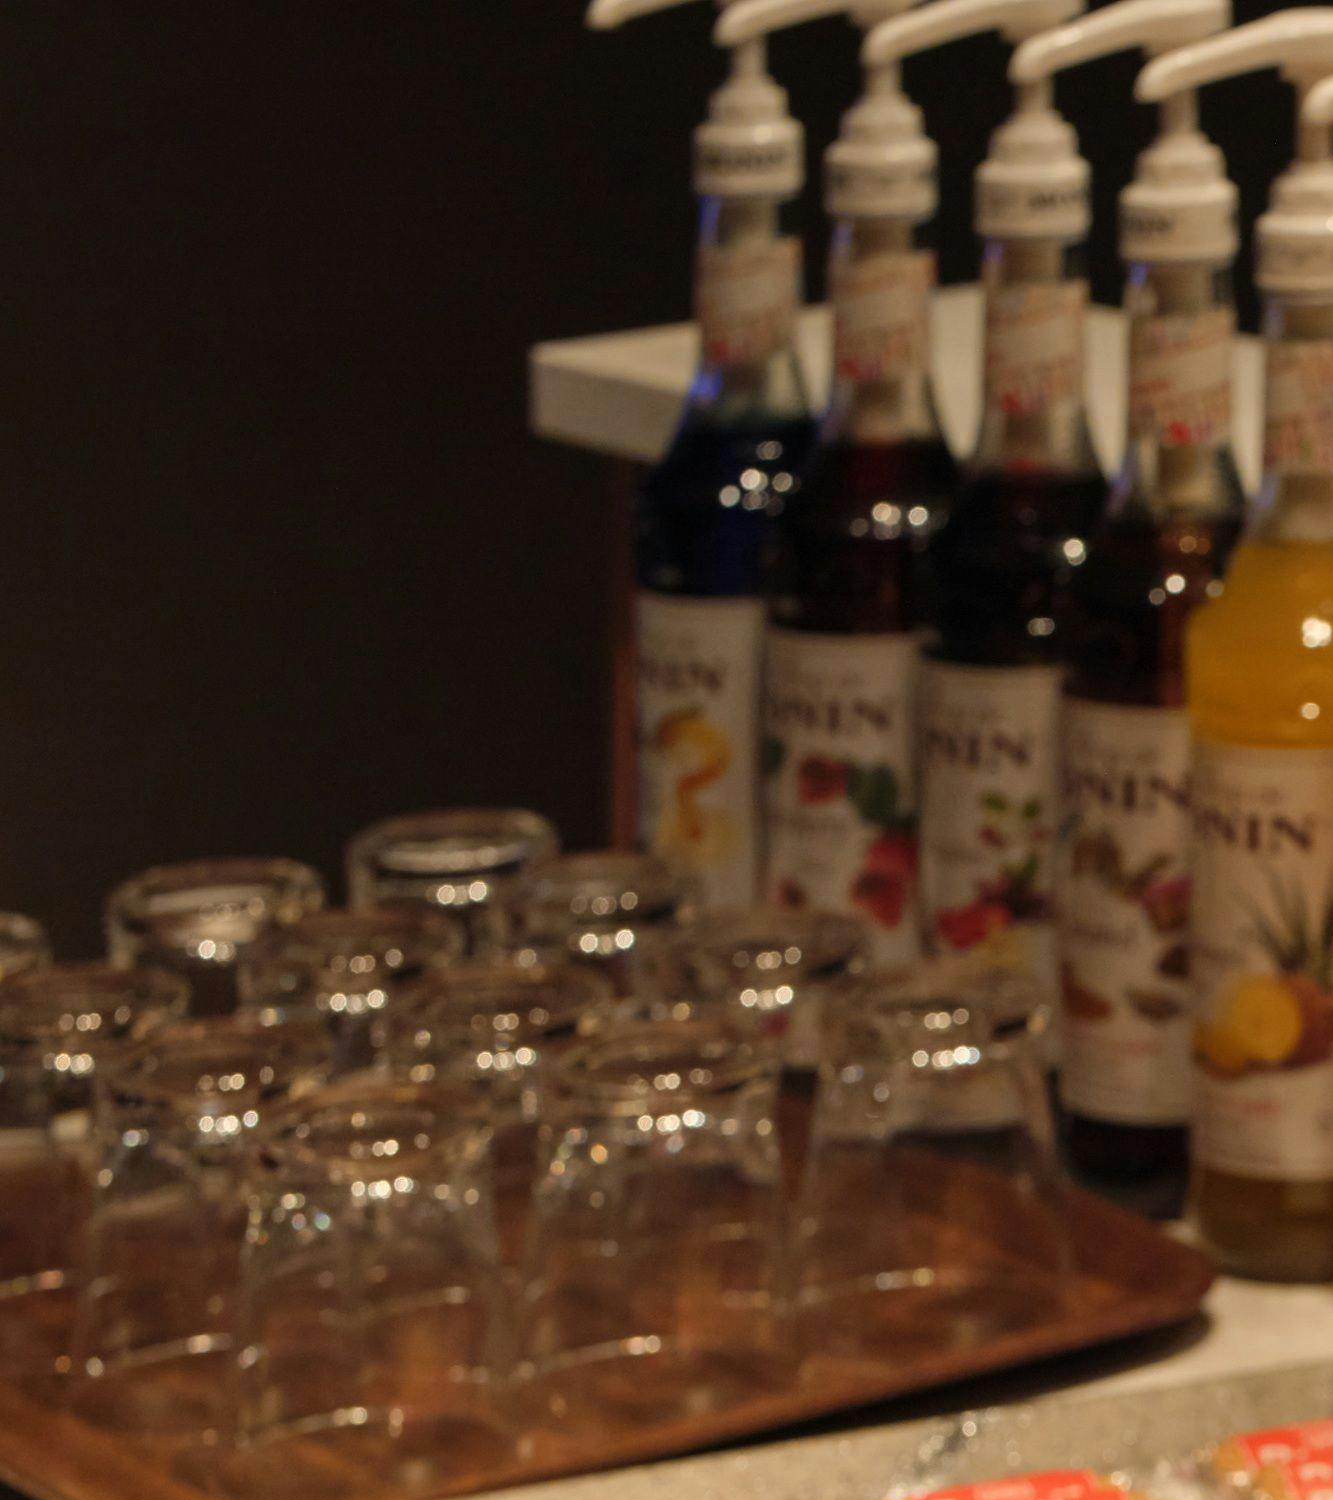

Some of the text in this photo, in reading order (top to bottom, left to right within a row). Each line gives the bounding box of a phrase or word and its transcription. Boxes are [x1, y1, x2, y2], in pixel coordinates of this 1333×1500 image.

[780, 697, 895, 734] NIN
[921, 728, 1035, 768] NIN
[1070, 771, 1192, 814] NIN
[1194, 807, 1316, 853] NIN
